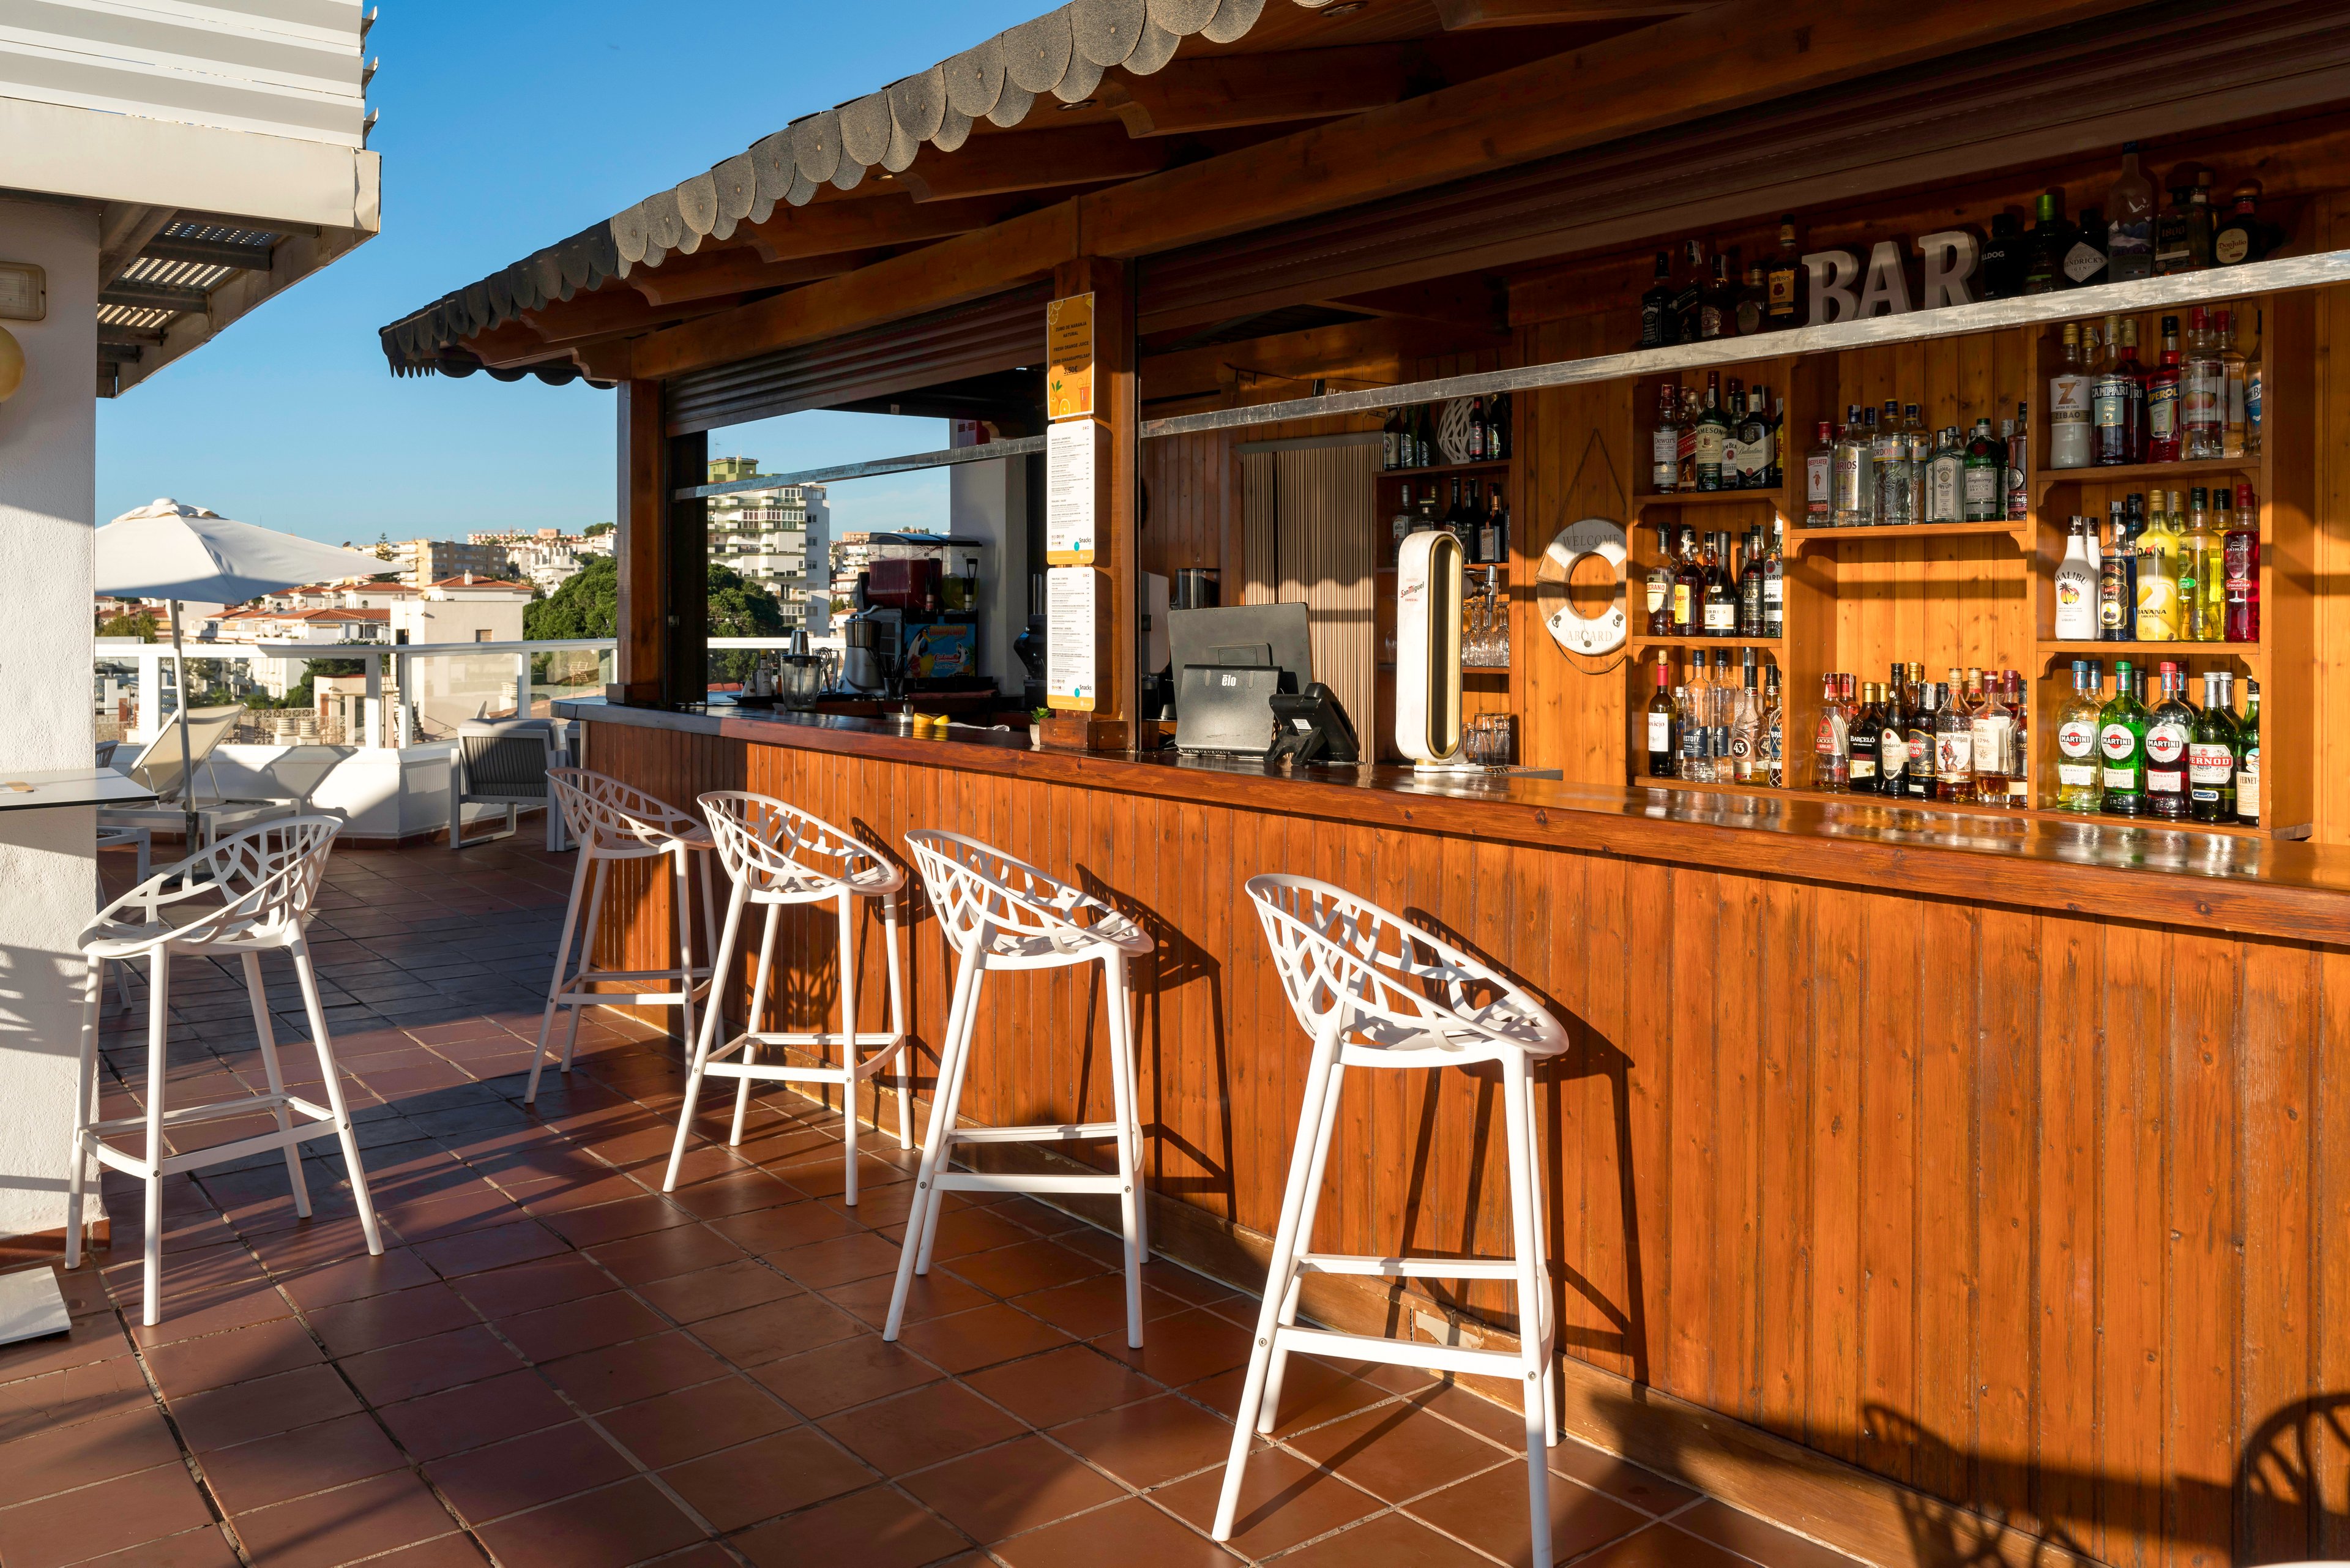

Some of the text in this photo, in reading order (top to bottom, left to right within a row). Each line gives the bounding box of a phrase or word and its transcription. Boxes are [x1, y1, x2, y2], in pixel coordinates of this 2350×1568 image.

[1982, 250, 2005, 261] LLDOG
[1802, 231, 1979, 327] BAR
[1064, 365, 1078, 375] 3,50€
[2092, 385, 2128, 398] CAMPARI
[2148, 387, 2178, 403] APEROL
[1836, 461, 1857, 471] ARIOS
[1562, 534, 1619, 547] WELCOME
[2056, 571, 2088, 585] MALIBU
[1567, 630, 1613, 642] ABOARD
[1950, 735, 1968, 744] Morgan
[1733, 742, 1745, 753] 43
[2240, 776, 2259, 785] FERNET-
